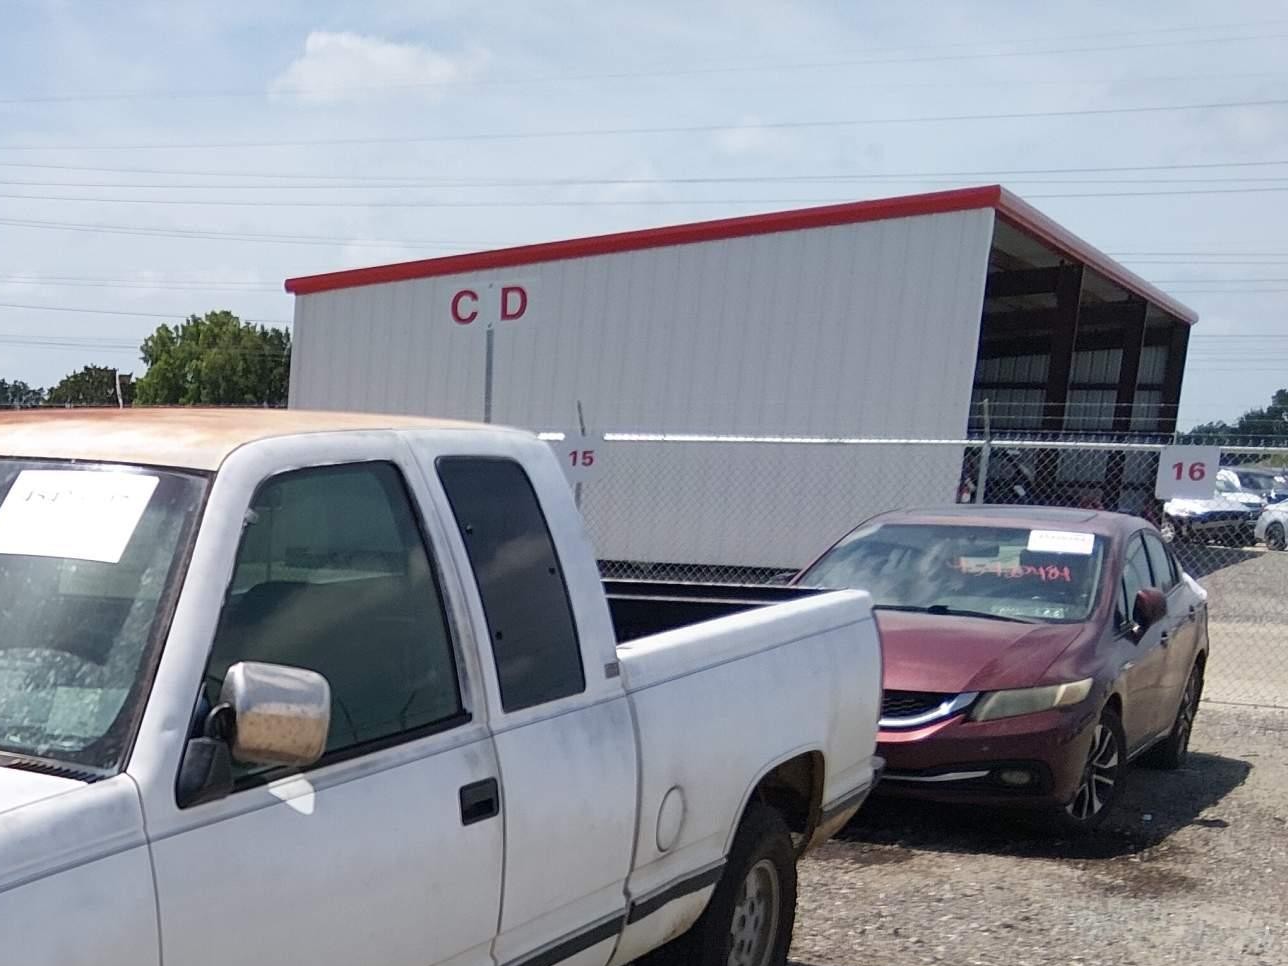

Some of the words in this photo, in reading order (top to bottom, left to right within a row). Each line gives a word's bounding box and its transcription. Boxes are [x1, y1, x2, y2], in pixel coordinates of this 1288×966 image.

[451, 289, 479, 325] C
[500, 286, 528, 321] D
[569, 450, 594, 467] 15
[1172, 461, 1206, 481] 16
